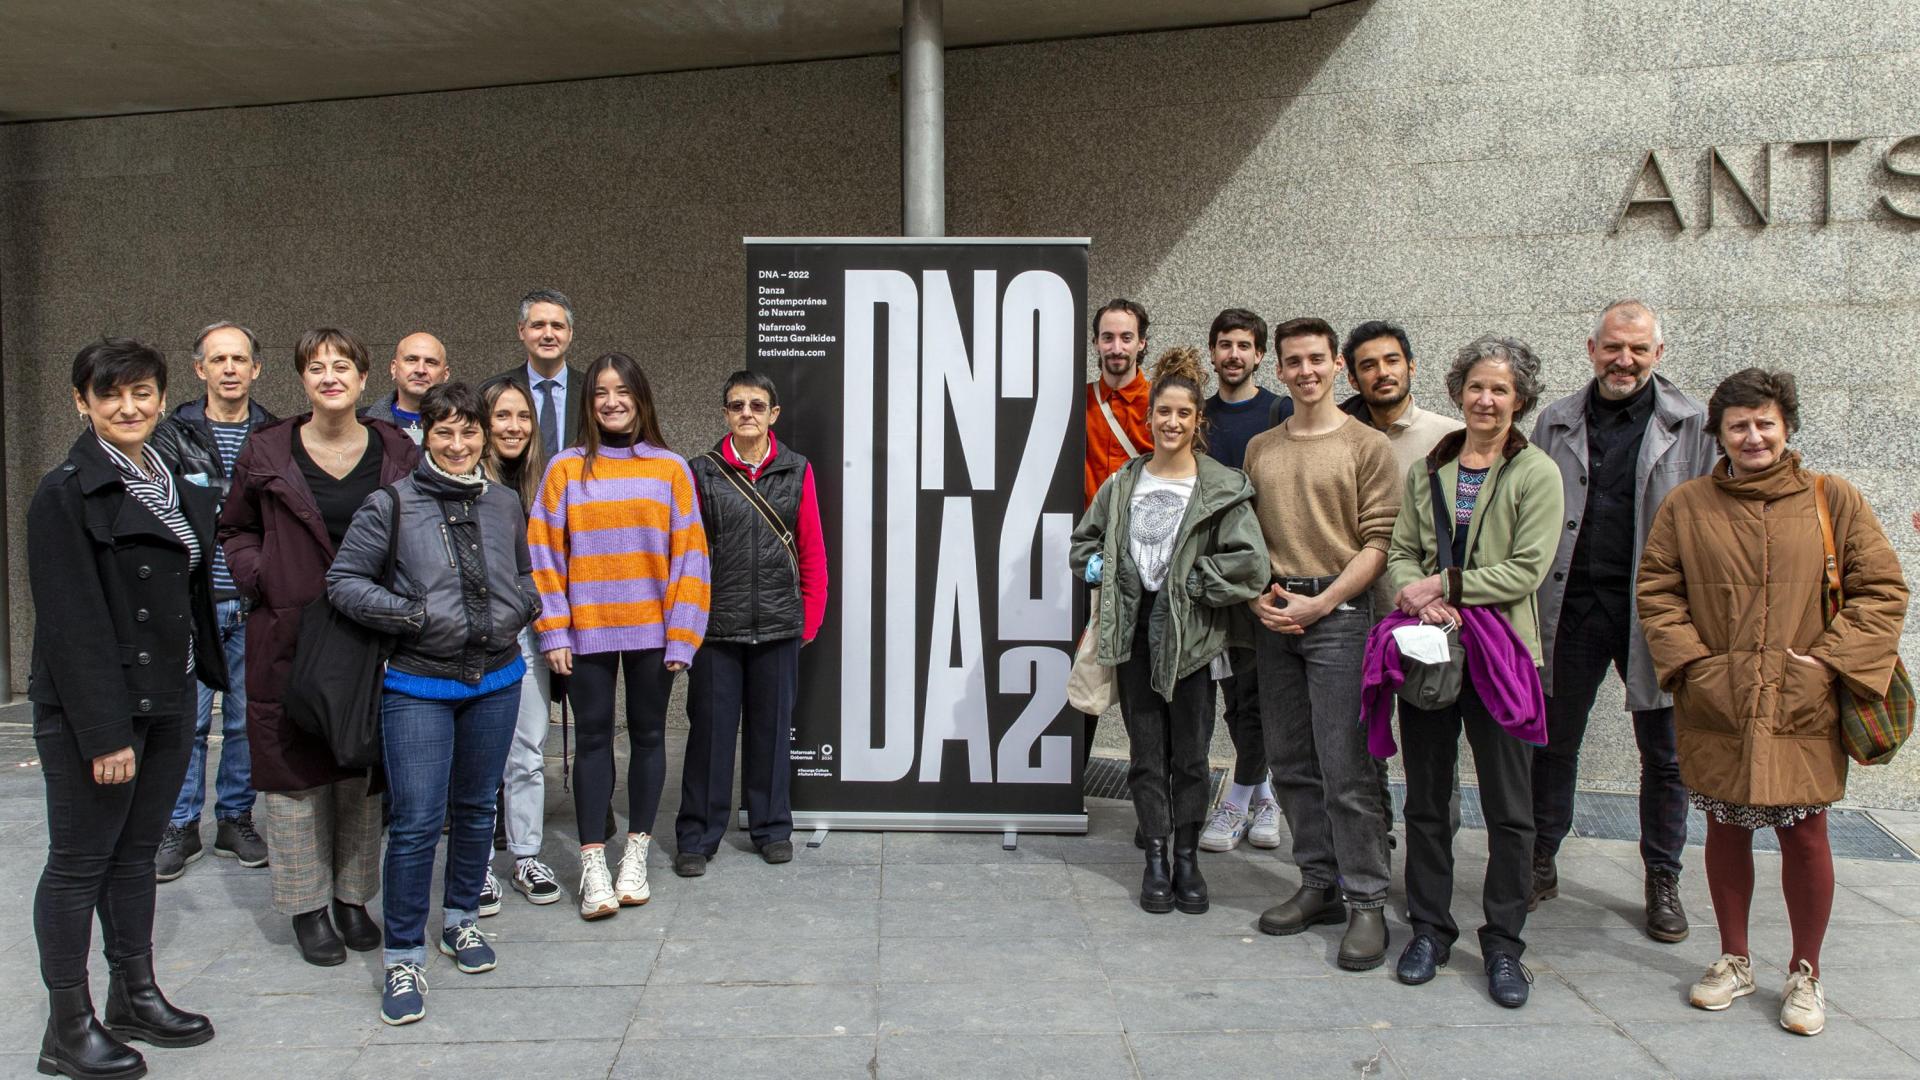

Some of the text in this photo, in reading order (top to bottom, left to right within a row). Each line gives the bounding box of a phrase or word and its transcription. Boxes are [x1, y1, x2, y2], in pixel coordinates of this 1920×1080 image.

[758, 270, 779, 279] DNA
[788, 270, 810, 279] 2022
[758, 286, 785, 295] Danza
[758, 297, 827, 307] Contemporánea
[758, 308, 805, 317] de Navarra
[758, 323, 806, 332] Nafarroako
[758, 334, 836, 342] Dantza Garaikidea
[758, 348, 826, 357] festivaldna.com
